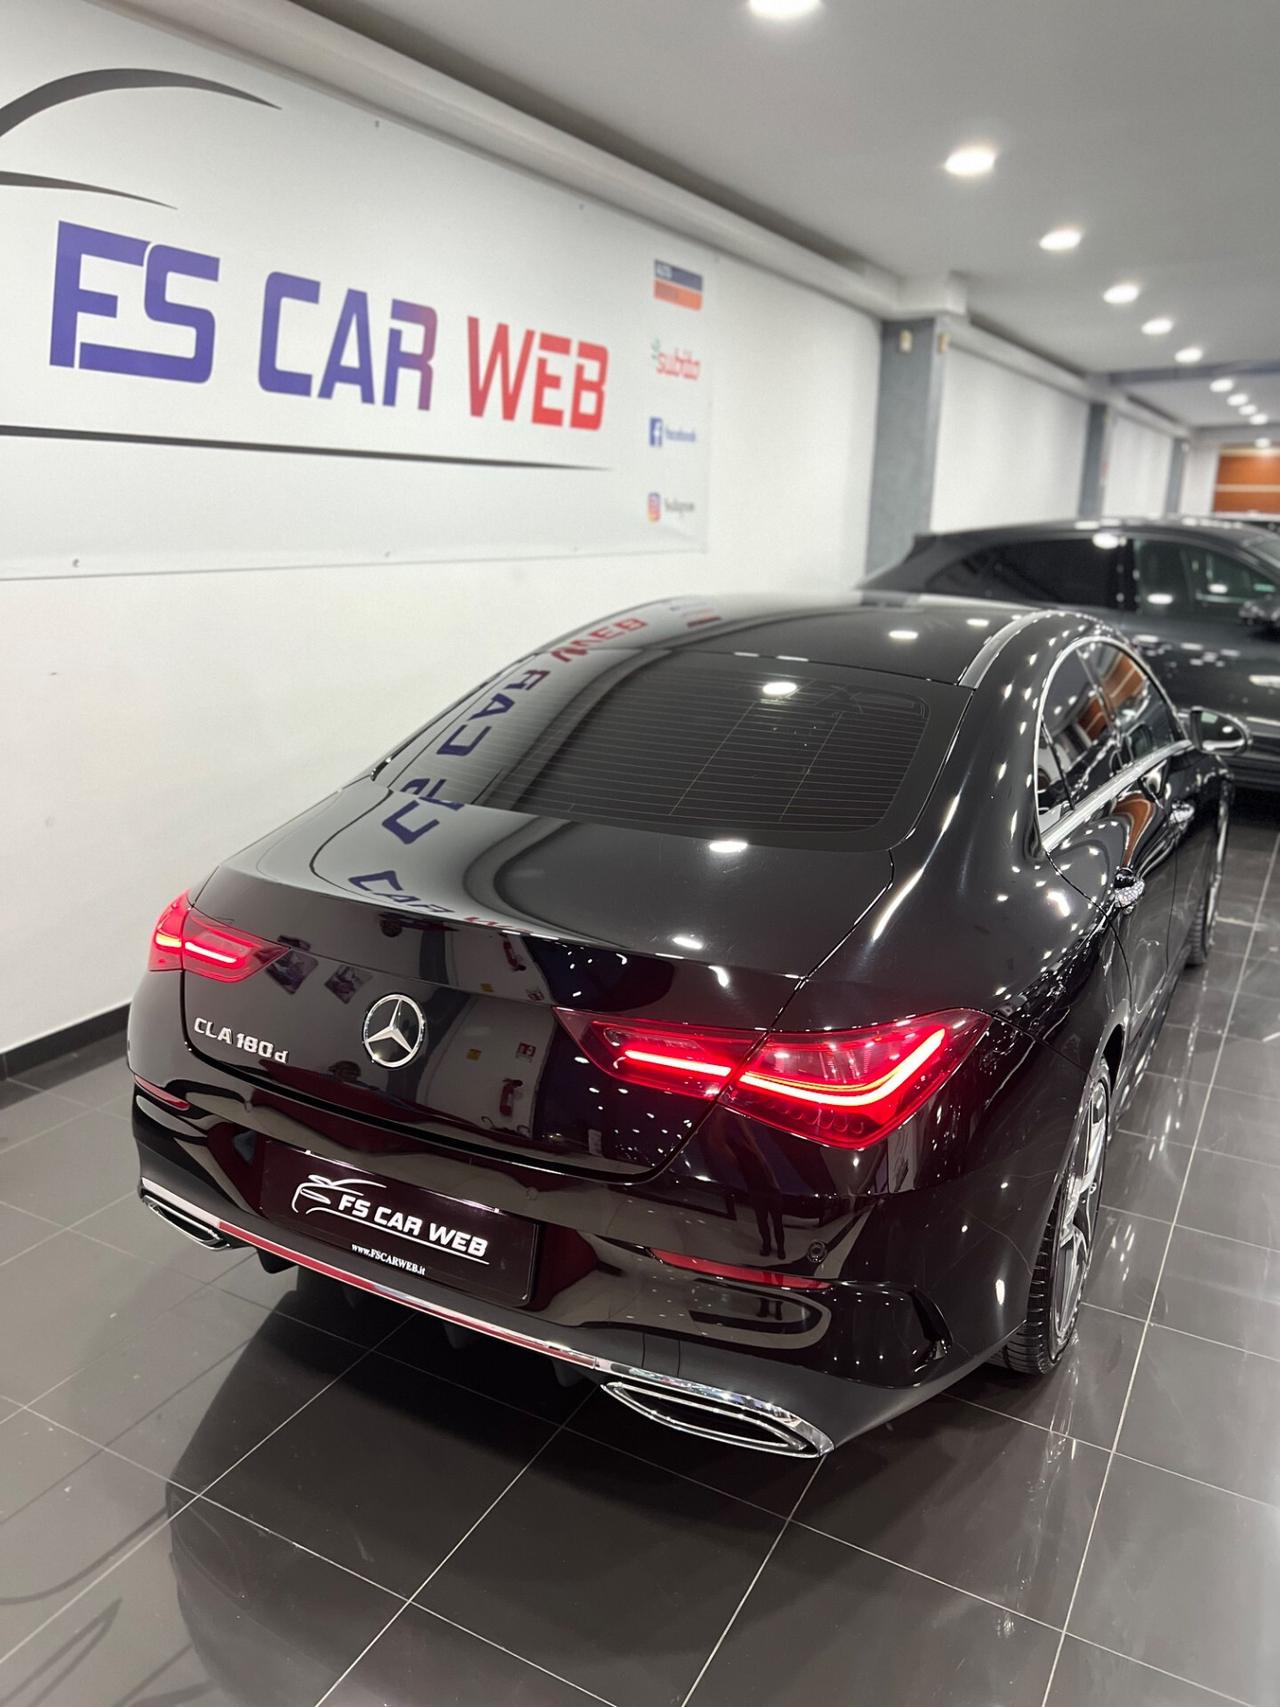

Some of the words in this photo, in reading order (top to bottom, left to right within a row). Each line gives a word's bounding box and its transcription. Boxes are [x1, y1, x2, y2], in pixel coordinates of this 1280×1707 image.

[258, 271, 438, 411] CAR
[467, 316, 609, 431] WEB
[194, 1017, 233, 1045] CLA
[236, 1032, 274, 1058] 180
[274, 1050, 289, 1064] d
[338, 1194, 371, 1218] FS
[374, 1207, 423, 1236] CAR
[428, 1223, 488, 1257] WEB
[351, 1243, 426, 1275] www.FSCARWEB.it
